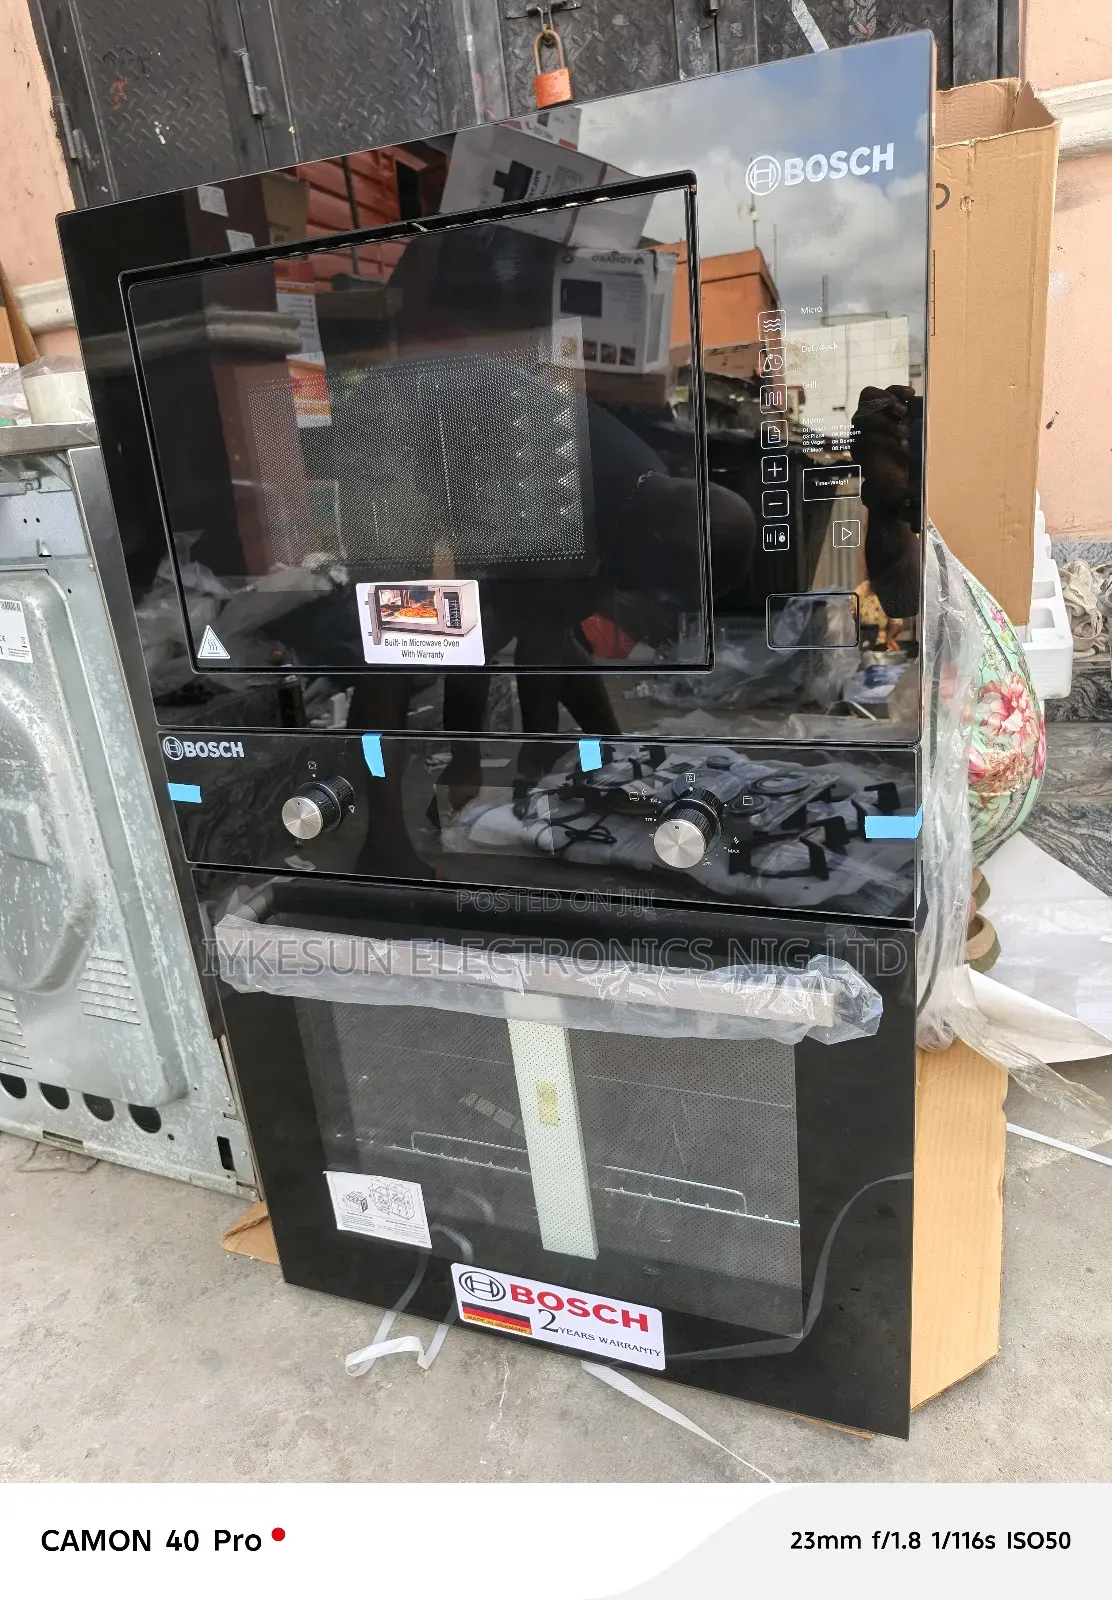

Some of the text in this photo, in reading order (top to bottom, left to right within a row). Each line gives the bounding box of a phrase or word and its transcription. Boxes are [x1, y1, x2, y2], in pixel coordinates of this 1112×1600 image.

[784, 143, 895, 186] BOSCH
[801, 306, 823, 314] Micro
[803, 381, 817, 389] Grill
[803, 417, 824, 425] Menu
[402, 638, 408, 647] In
[409, 638, 442, 647] Microwave
[443, 638, 460, 648] Oven
[402, 649, 445, 661] With Warranty
[183, 741, 245, 758] BOSCH
[510, 1283, 649, 1333] BOSCH
[467, 1315, 485, 1323] MADE
[598, 1336, 661, 1357] WARRANTY
